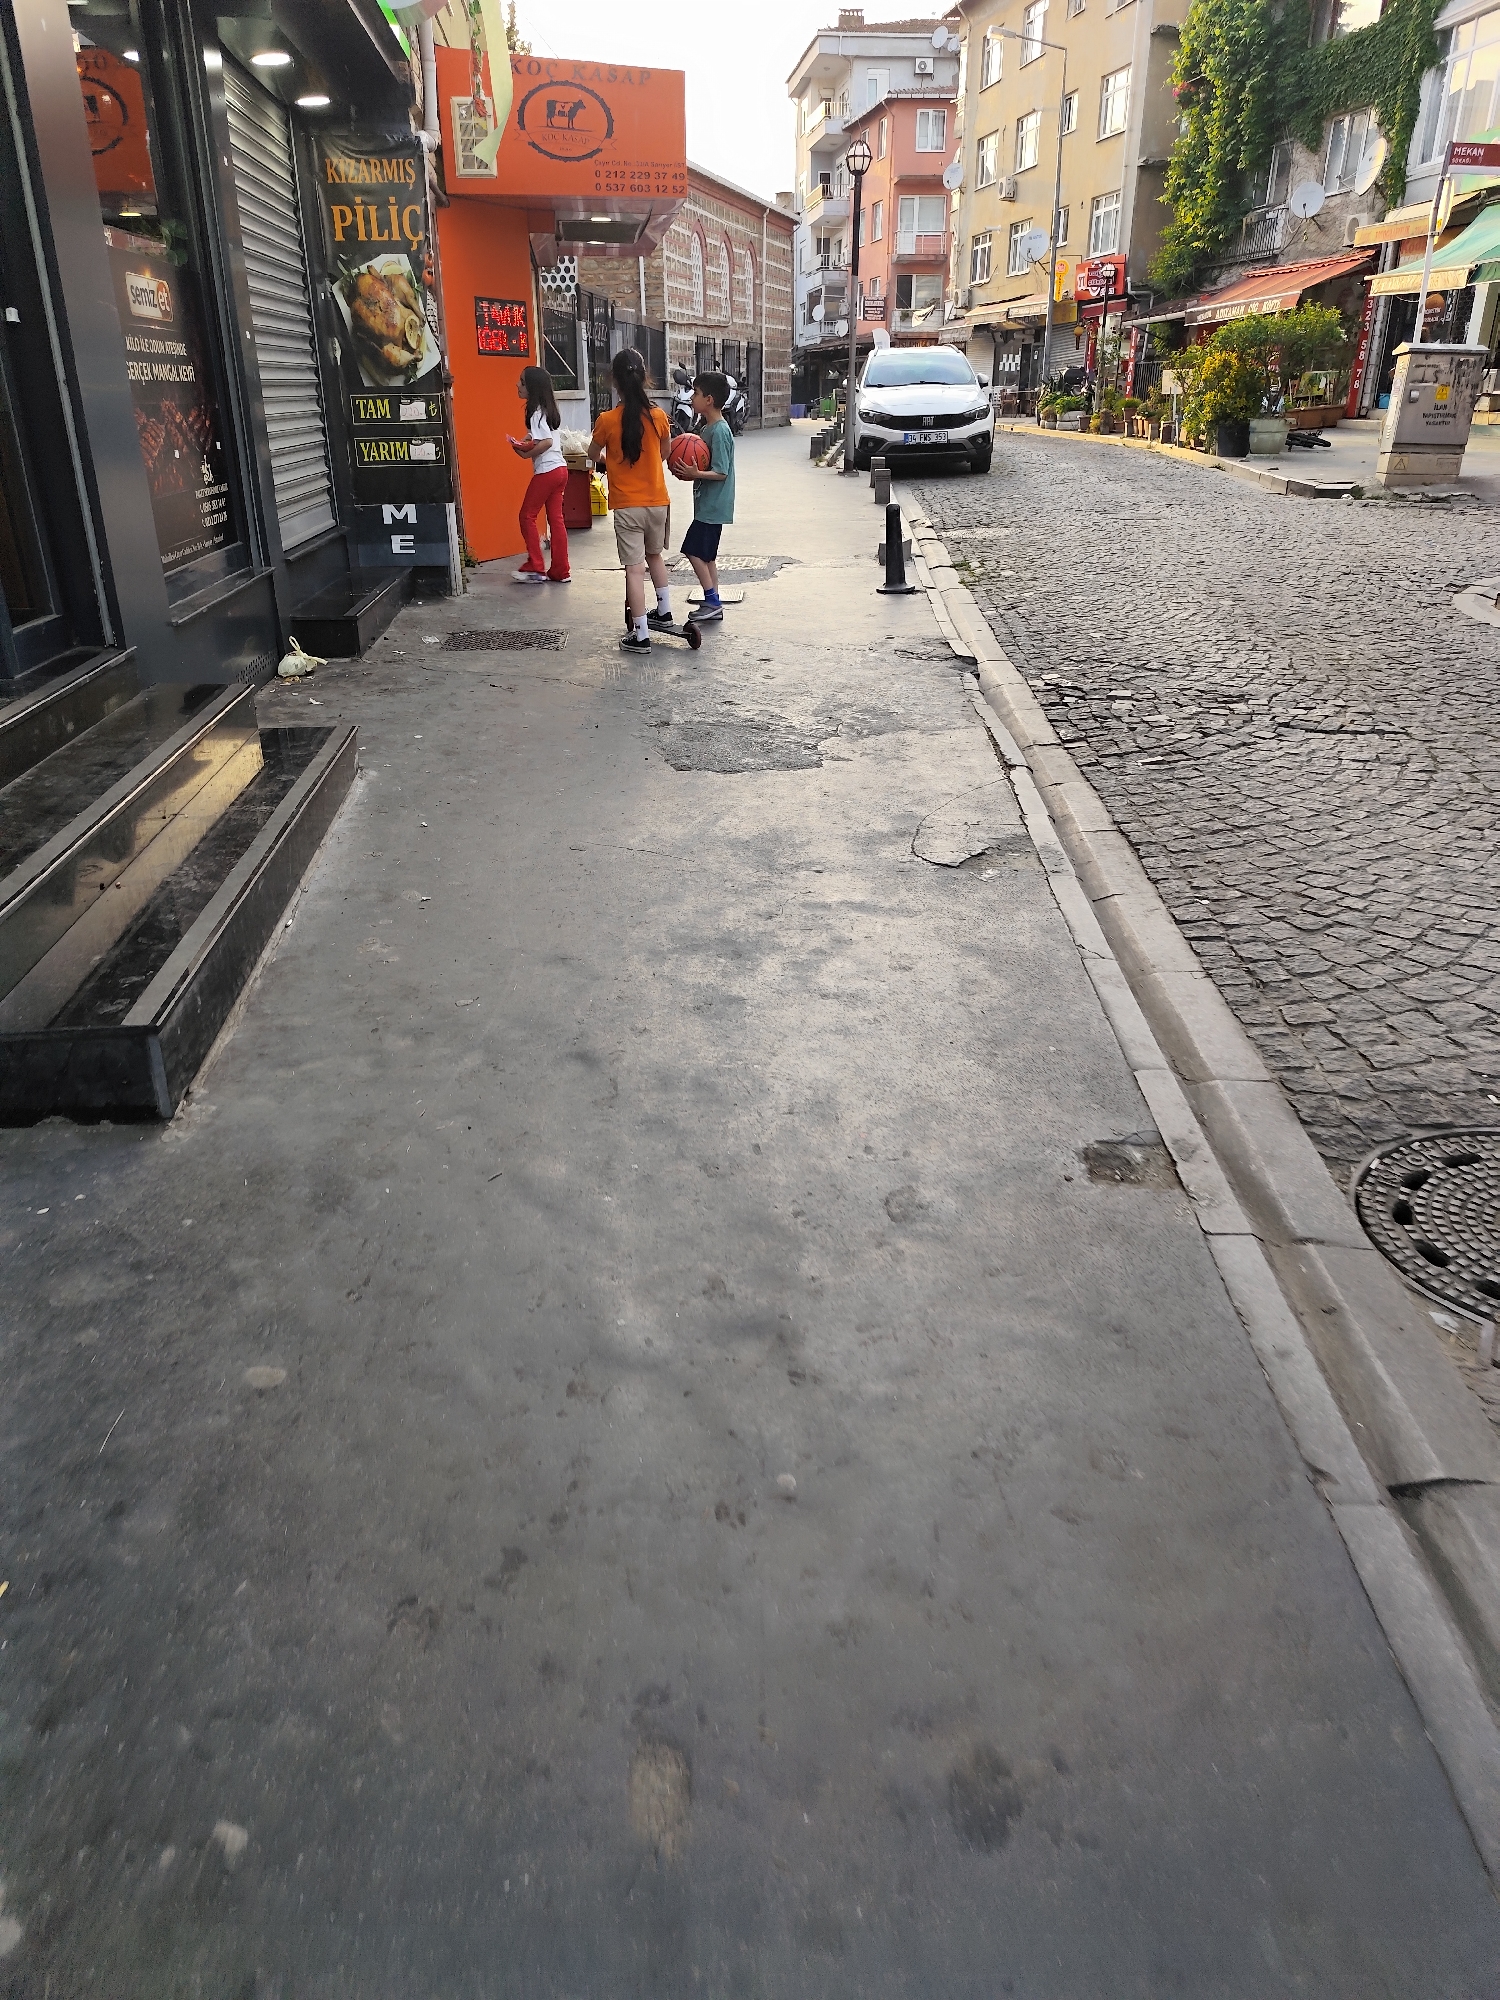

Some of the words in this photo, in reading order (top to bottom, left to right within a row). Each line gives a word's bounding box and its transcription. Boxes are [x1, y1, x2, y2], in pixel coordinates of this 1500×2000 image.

[571, 64, 653, 86] KASAP
[1453, 146, 1486, 157] MEKAN
[325, 158, 416, 190] KIZARMIŞ
[594, 169, 601, 178] 0
[605, 170, 626, 179] 212
[629, 171, 651, 180] 229
[654, 171, 668, 180] 37
[671, 172, 685, 181] 49
[595, 182, 602, 191] 0
[605, 183, 626, 192] 537
[629, 184, 651, 193] 603
[655, 184, 668, 193] 12
[672, 185, 685, 194] 52
[330, 196, 424, 251] PİLİÇ
[152, 362, 180, 381] MANGAL
[356, 399, 391, 419] TAM
[1433, 402, 1448, 411] İLAN
[909, 434, 917, 443] 34
[935, 432, 947, 441] 353
[360, 442, 410, 461] YARIM
